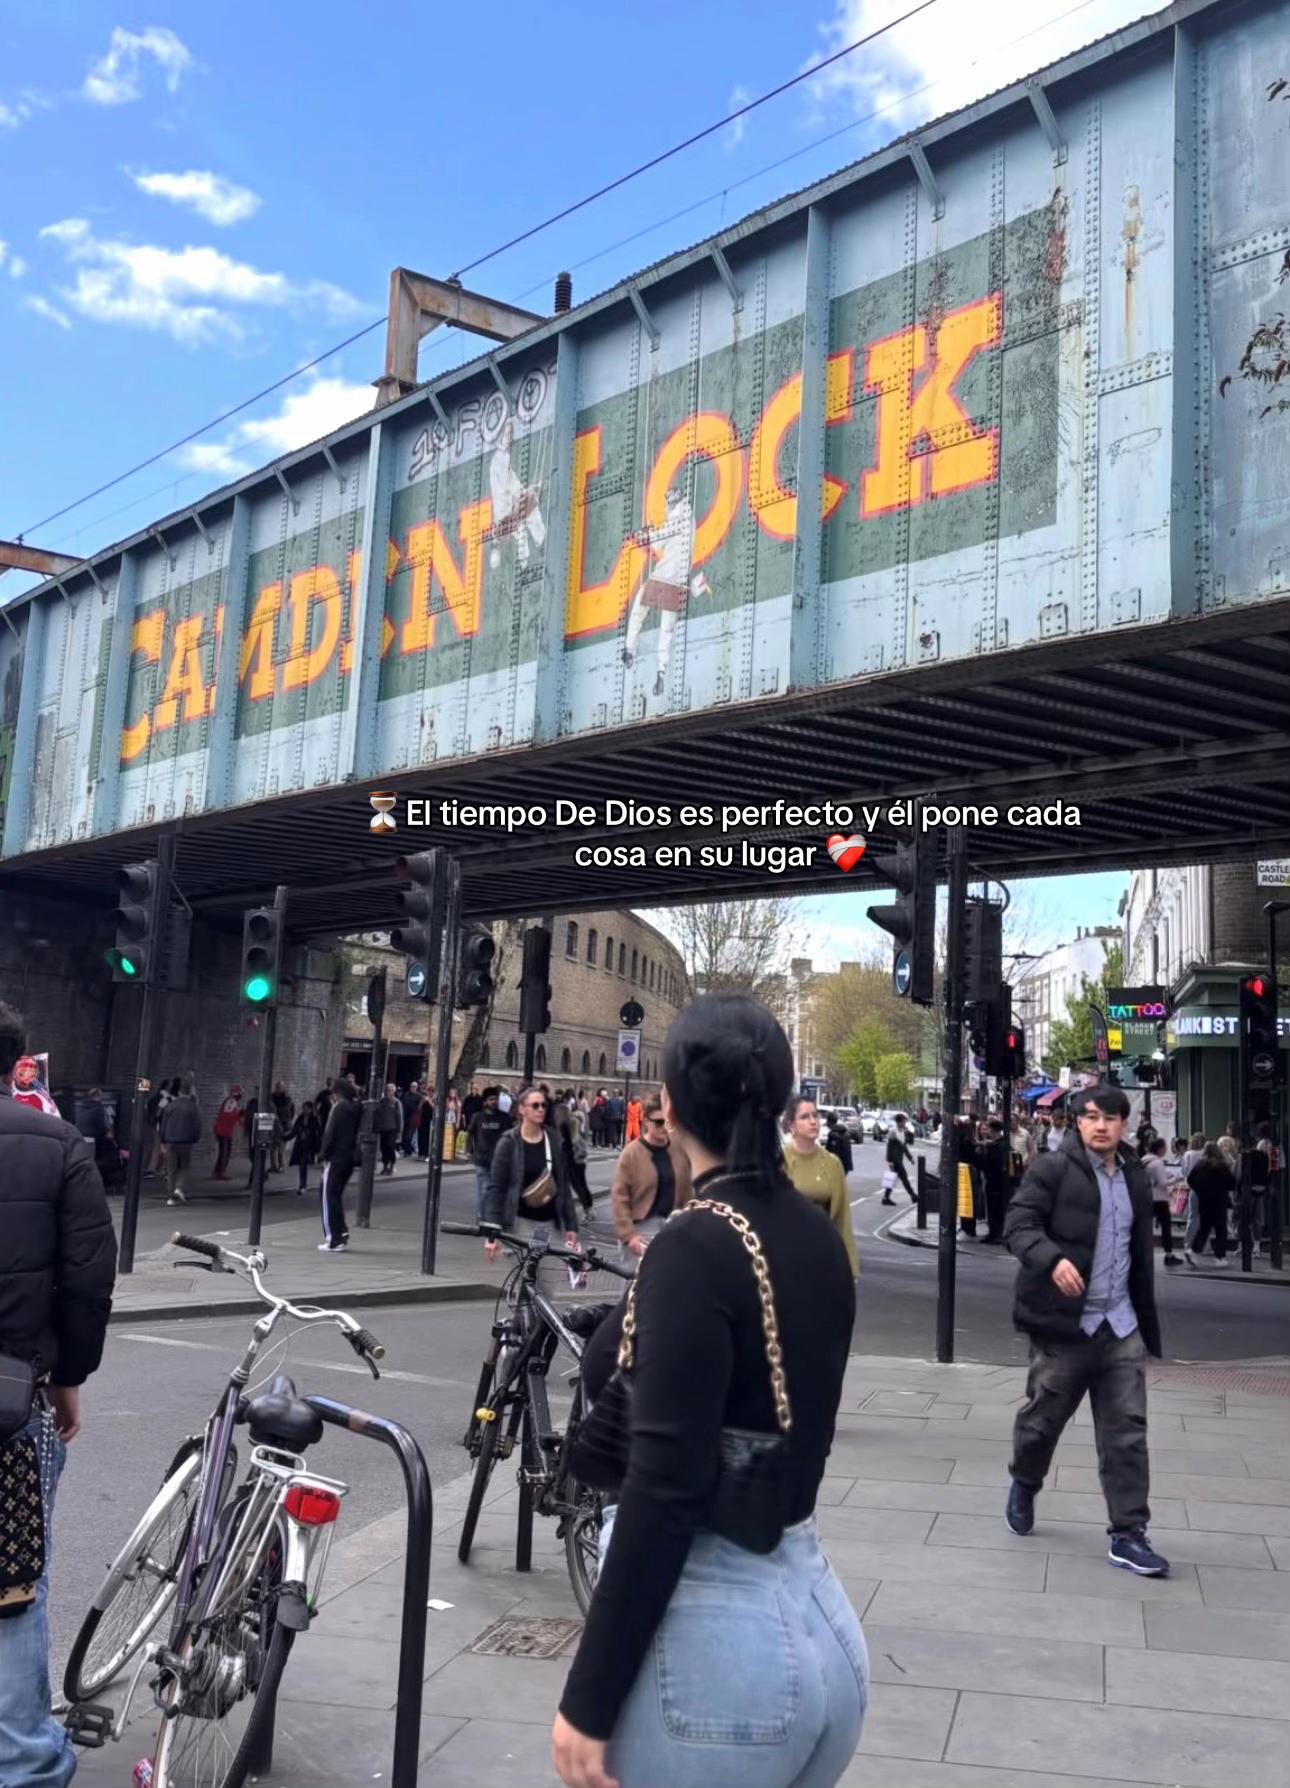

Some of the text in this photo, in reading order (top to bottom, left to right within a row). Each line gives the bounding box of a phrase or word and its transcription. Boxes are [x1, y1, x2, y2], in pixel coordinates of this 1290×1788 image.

[408, 365, 558, 482] 10FOO
[565, 290, 1002, 640] LOCK
[1108, 1003, 1164, 1018] TATTOO
